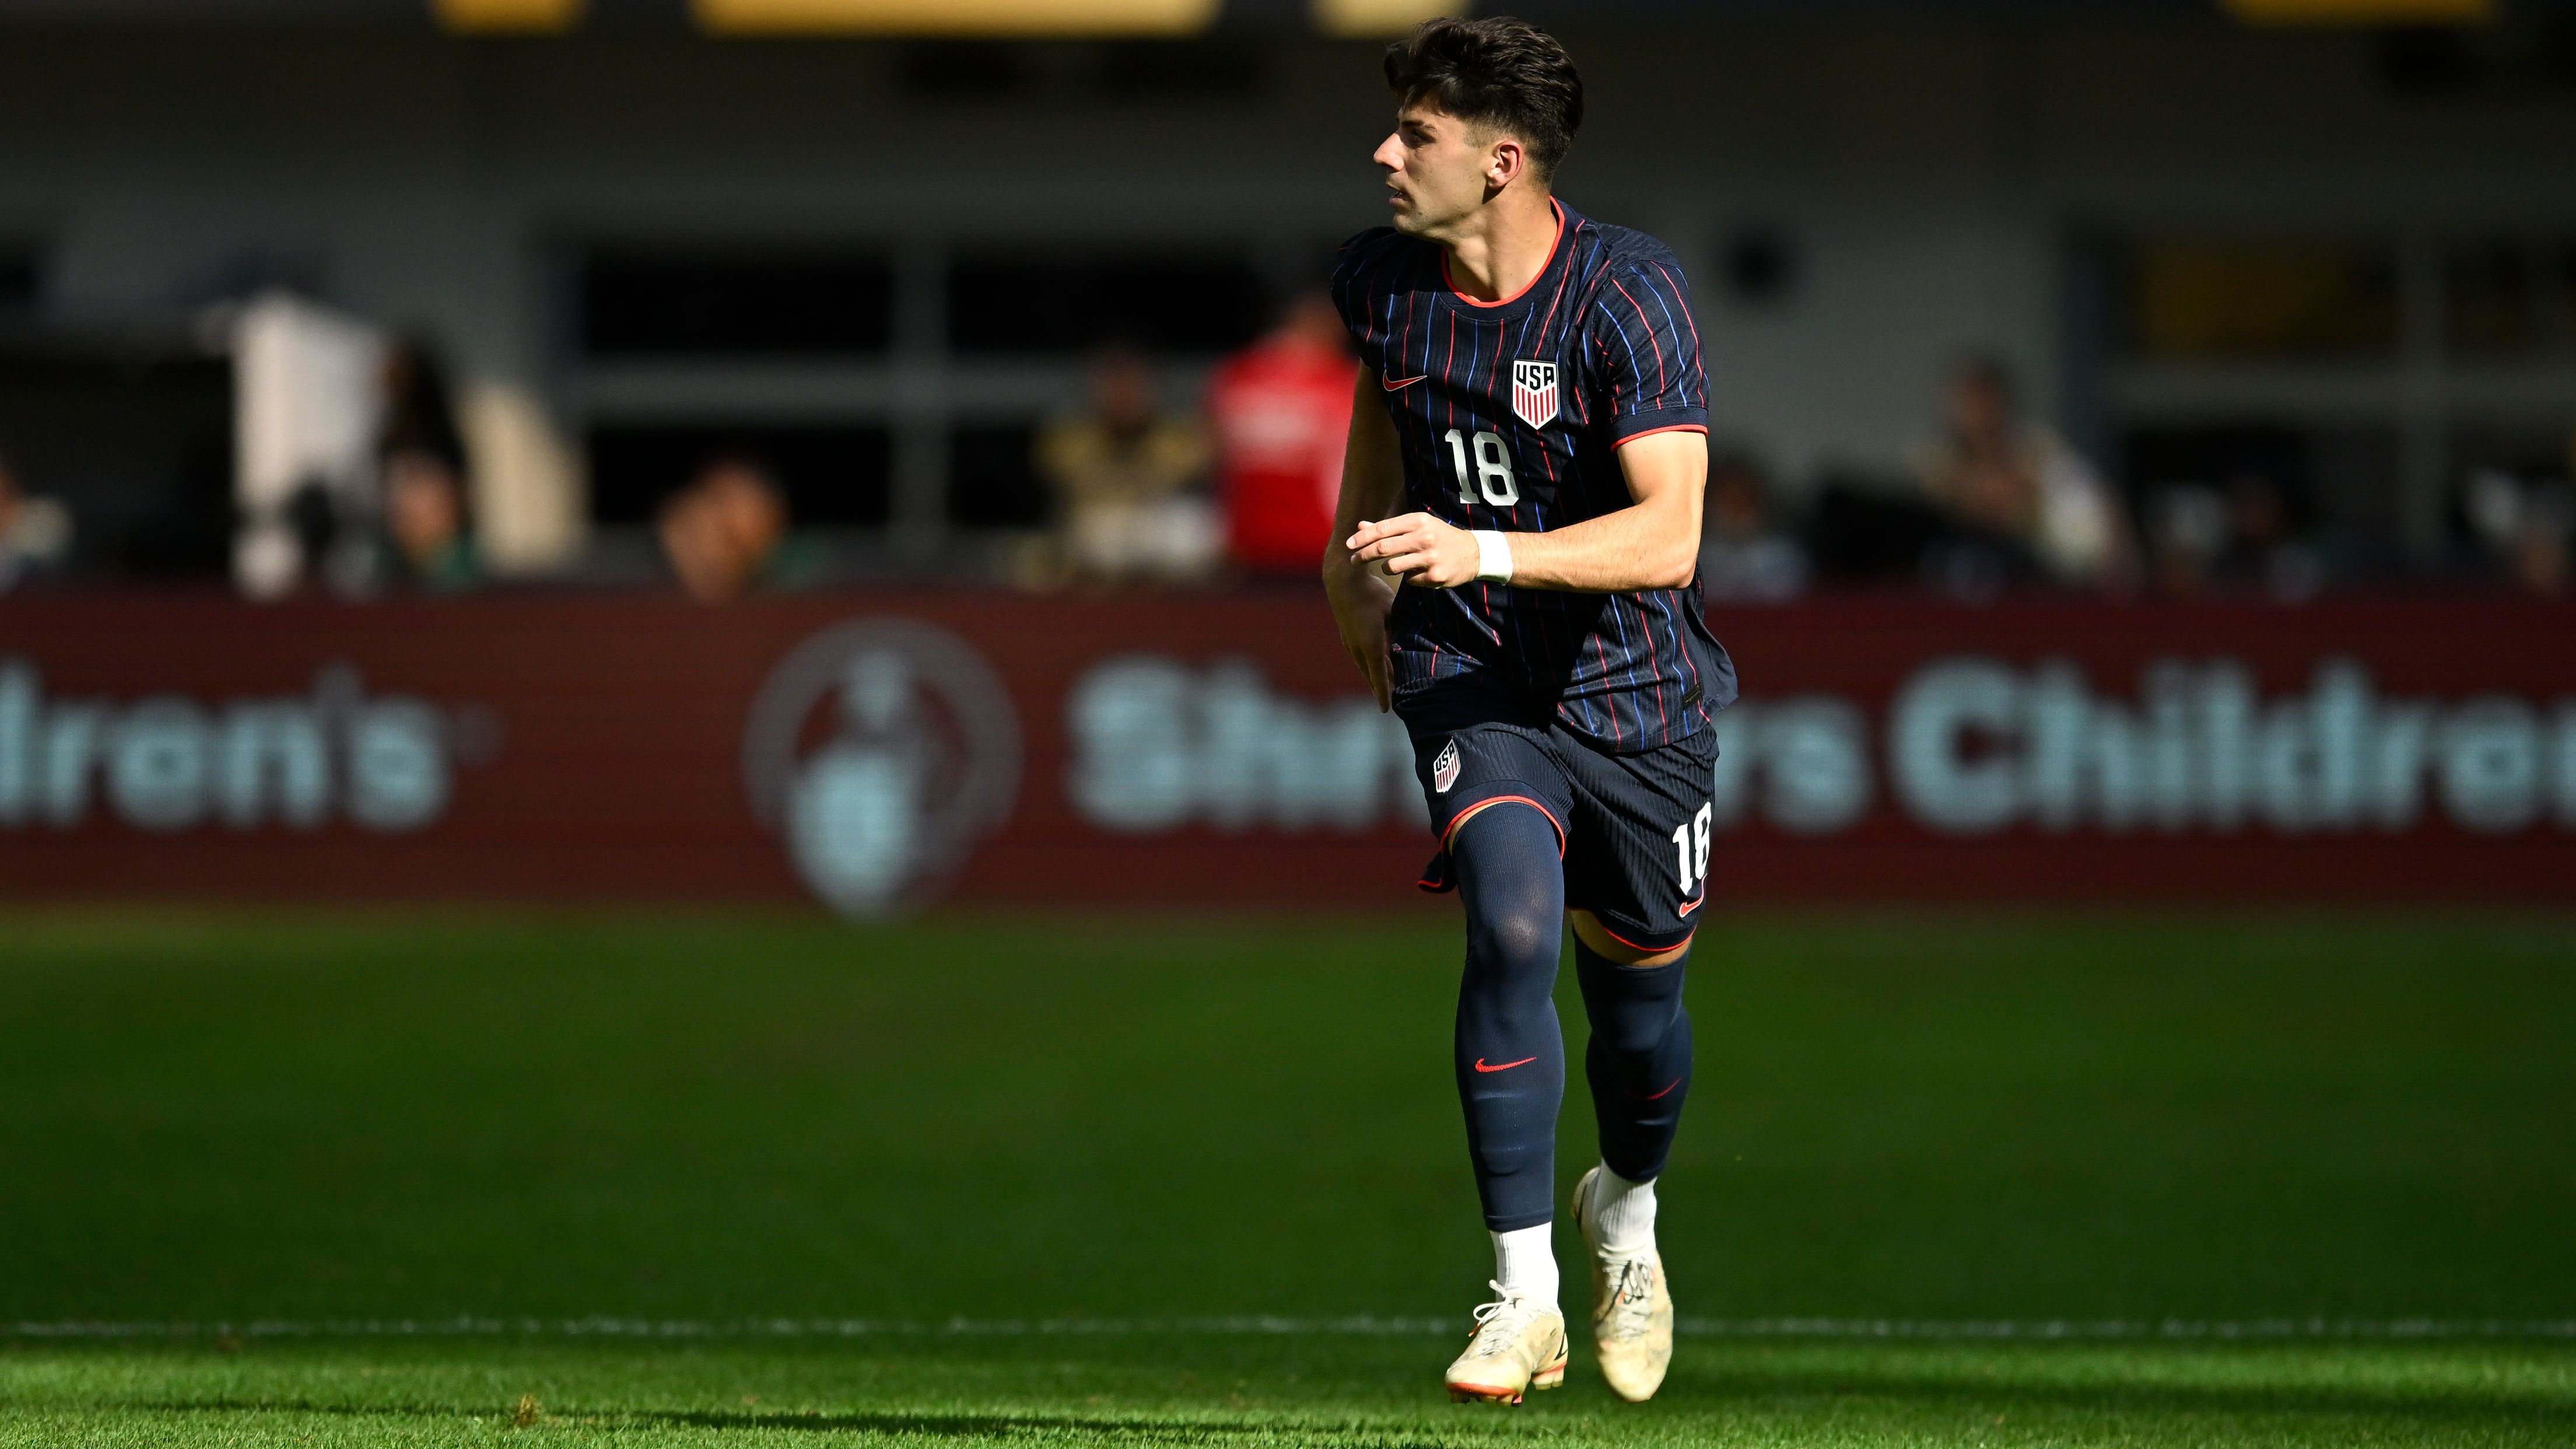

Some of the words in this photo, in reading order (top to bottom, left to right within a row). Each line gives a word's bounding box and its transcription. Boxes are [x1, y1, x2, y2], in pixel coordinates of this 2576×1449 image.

[1516, 364, 1554, 391] USA
[1445, 429, 1519, 506] 18
[1436, 741, 1455, 772] USA
[1891, 664, 2576, 826] Childre
[1672, 801, 1712, 896] 18
